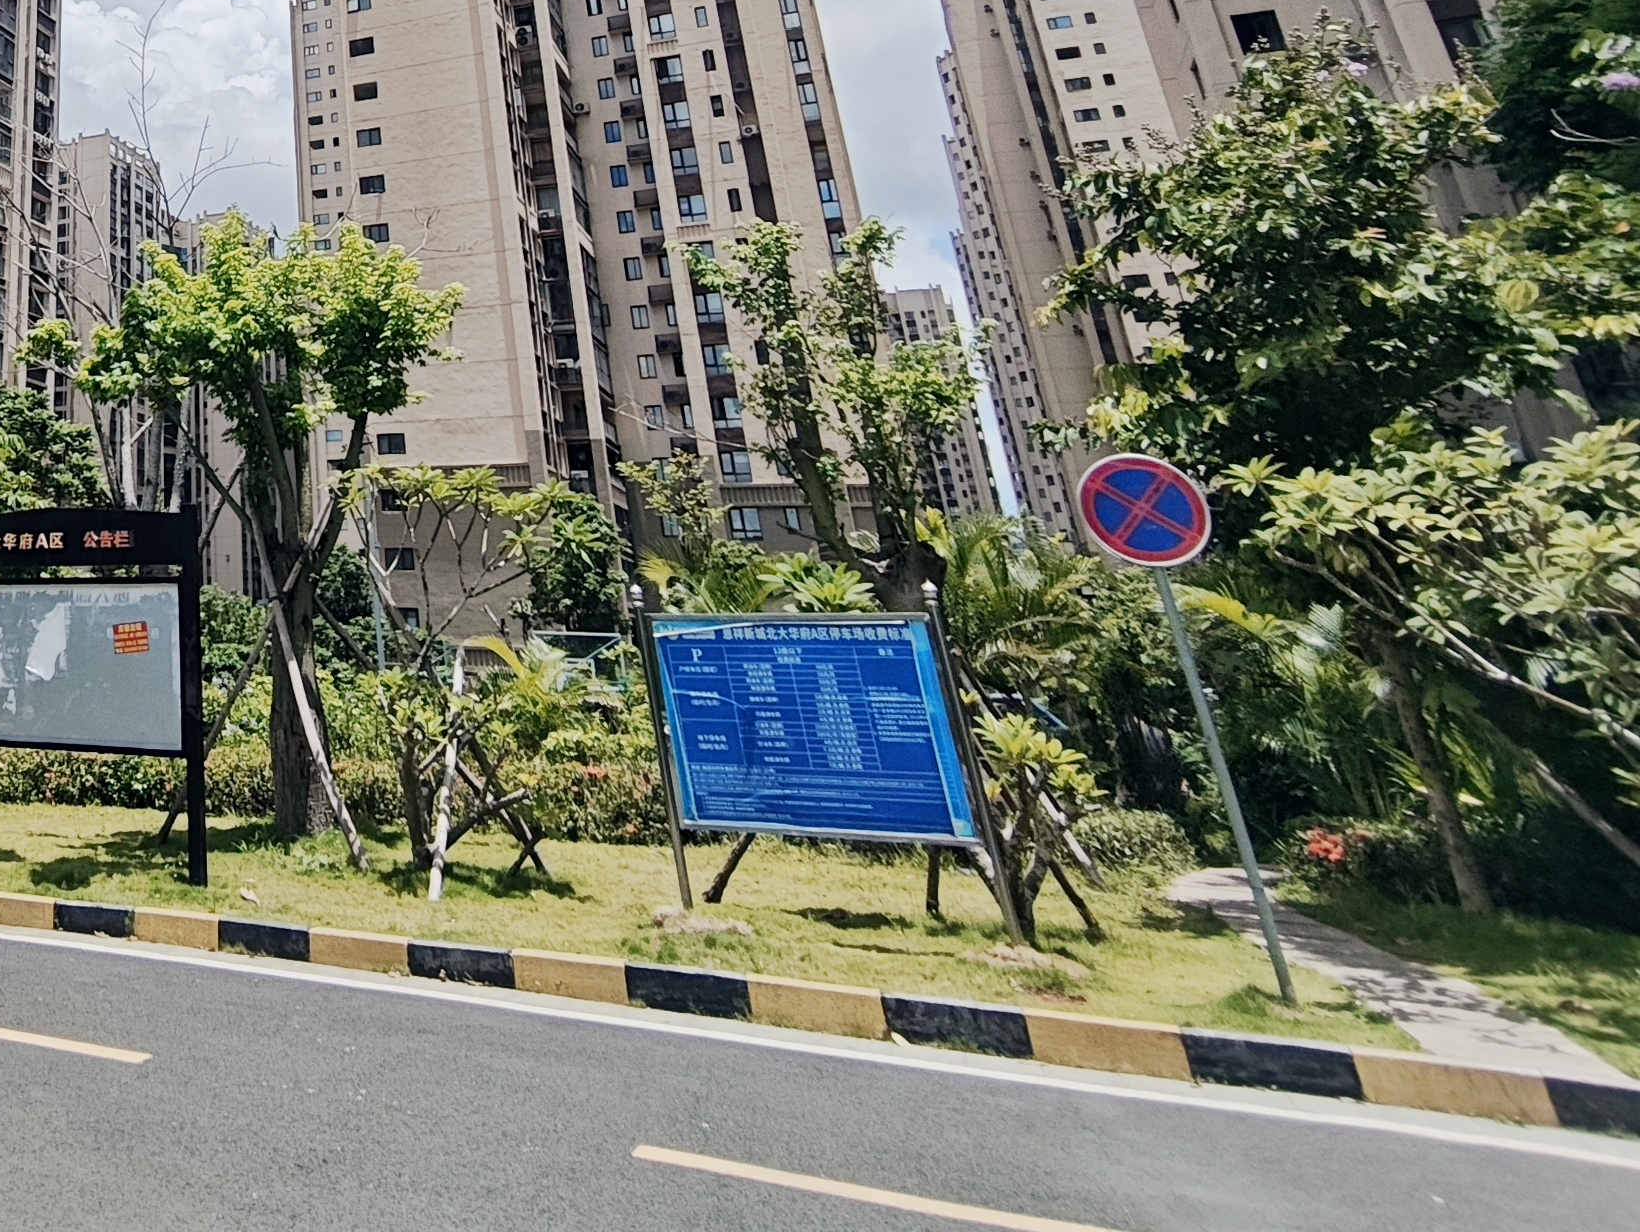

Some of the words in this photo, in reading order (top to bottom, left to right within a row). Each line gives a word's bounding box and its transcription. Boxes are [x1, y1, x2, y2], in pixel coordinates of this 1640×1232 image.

[83, 530, 131, 549] 公告栏
[690, 648, 703, 663] P
